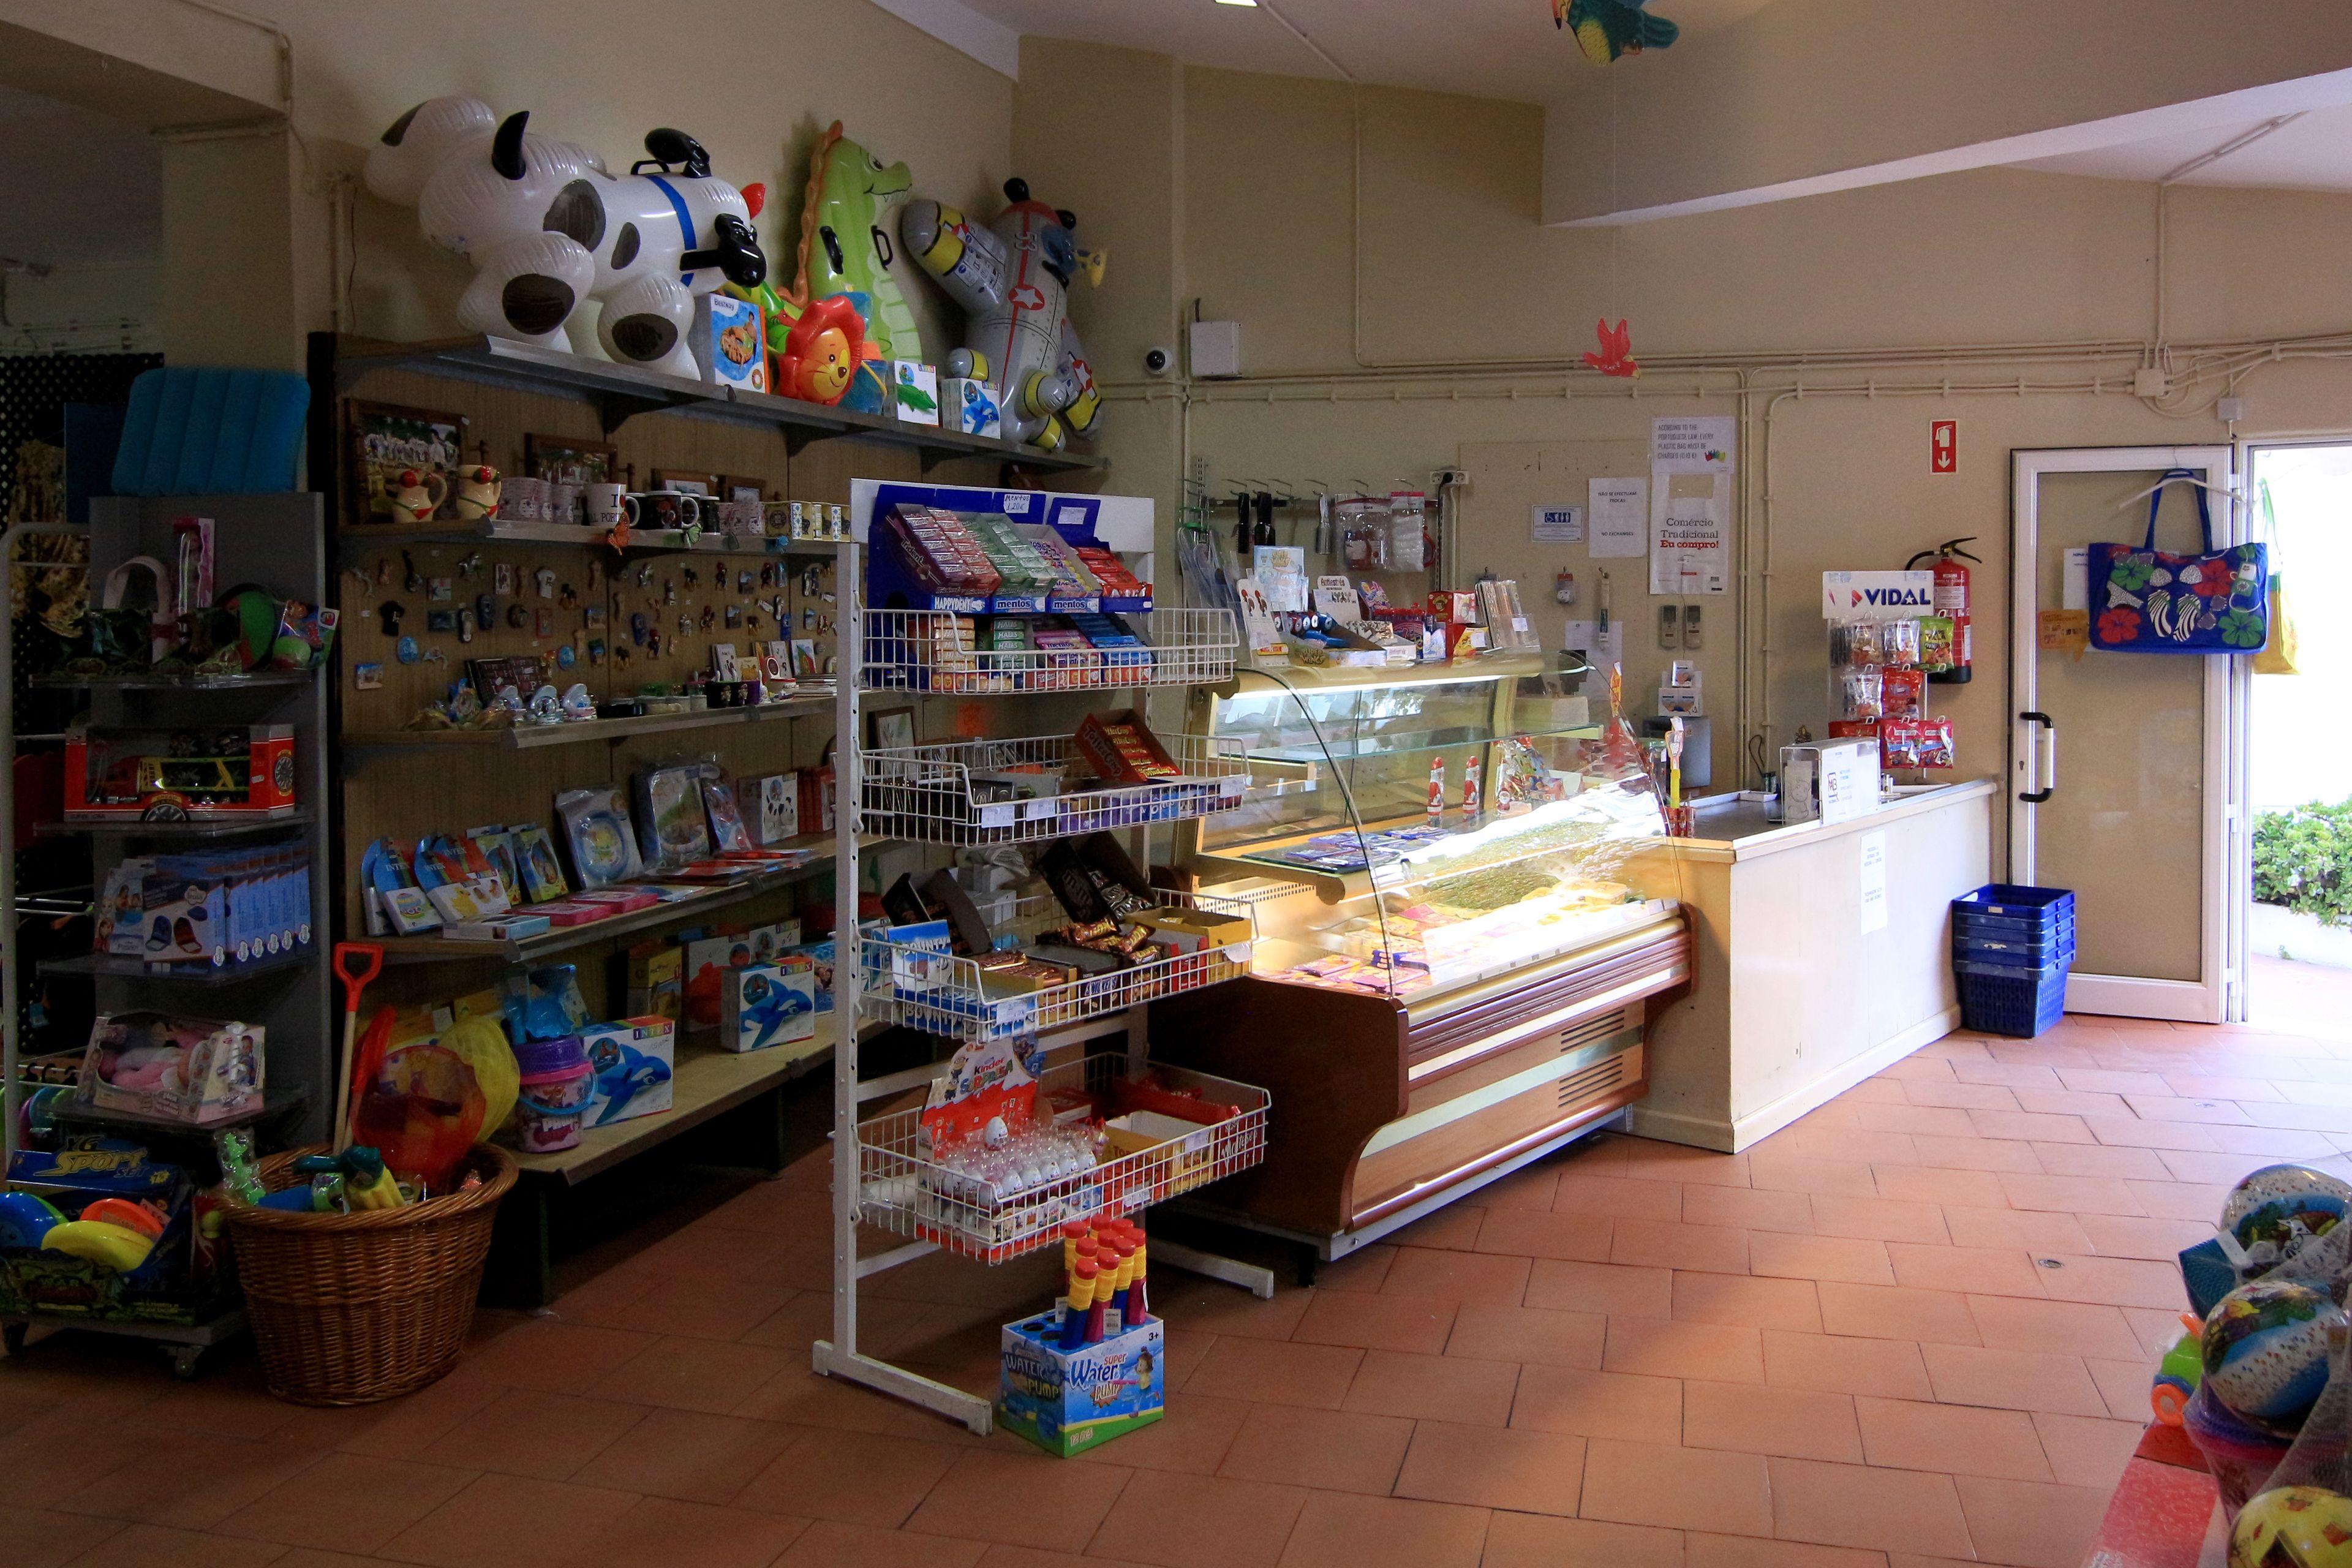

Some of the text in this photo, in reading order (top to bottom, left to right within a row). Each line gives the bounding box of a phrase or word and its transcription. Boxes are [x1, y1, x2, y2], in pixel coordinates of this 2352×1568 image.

[714, 298, 734, 311] Bestway
[610, 494, 618, 508] I
[1666, 518, 1713, 526] Comércio
[1660, 530, 1718, 538] Tradicional
[1676, 540, 1719, 550] compro!
[900, 535, 924, 570] Trident
[935, 597, 971, 611] HAPPYDENT
[997, 599, 1031, 608] mentos
[1054, 599, 1086, 609] mentos
[1864, 588, 1931, 606] VIDAL
[904, 937, 948, 954] BOUNTY
[780, 962, 813, 976] INTEX
[905, 1005, 958, 1025] BOUNTY
[633, 1023, 673, 1040] INTEX
[974, 1056, 1005, 1075] Kinder
[1148, 1332, 1159, 1341] 3+
[1005, 1352, 1043, 1379] WATER
[1104, 1353, 1127, 1366] super
[1071, 1359, 1118, 1390] Water
[1027, 1378, 1060, 1399] PUMP
[1094, 1382, 1121, 1401] PUMP
